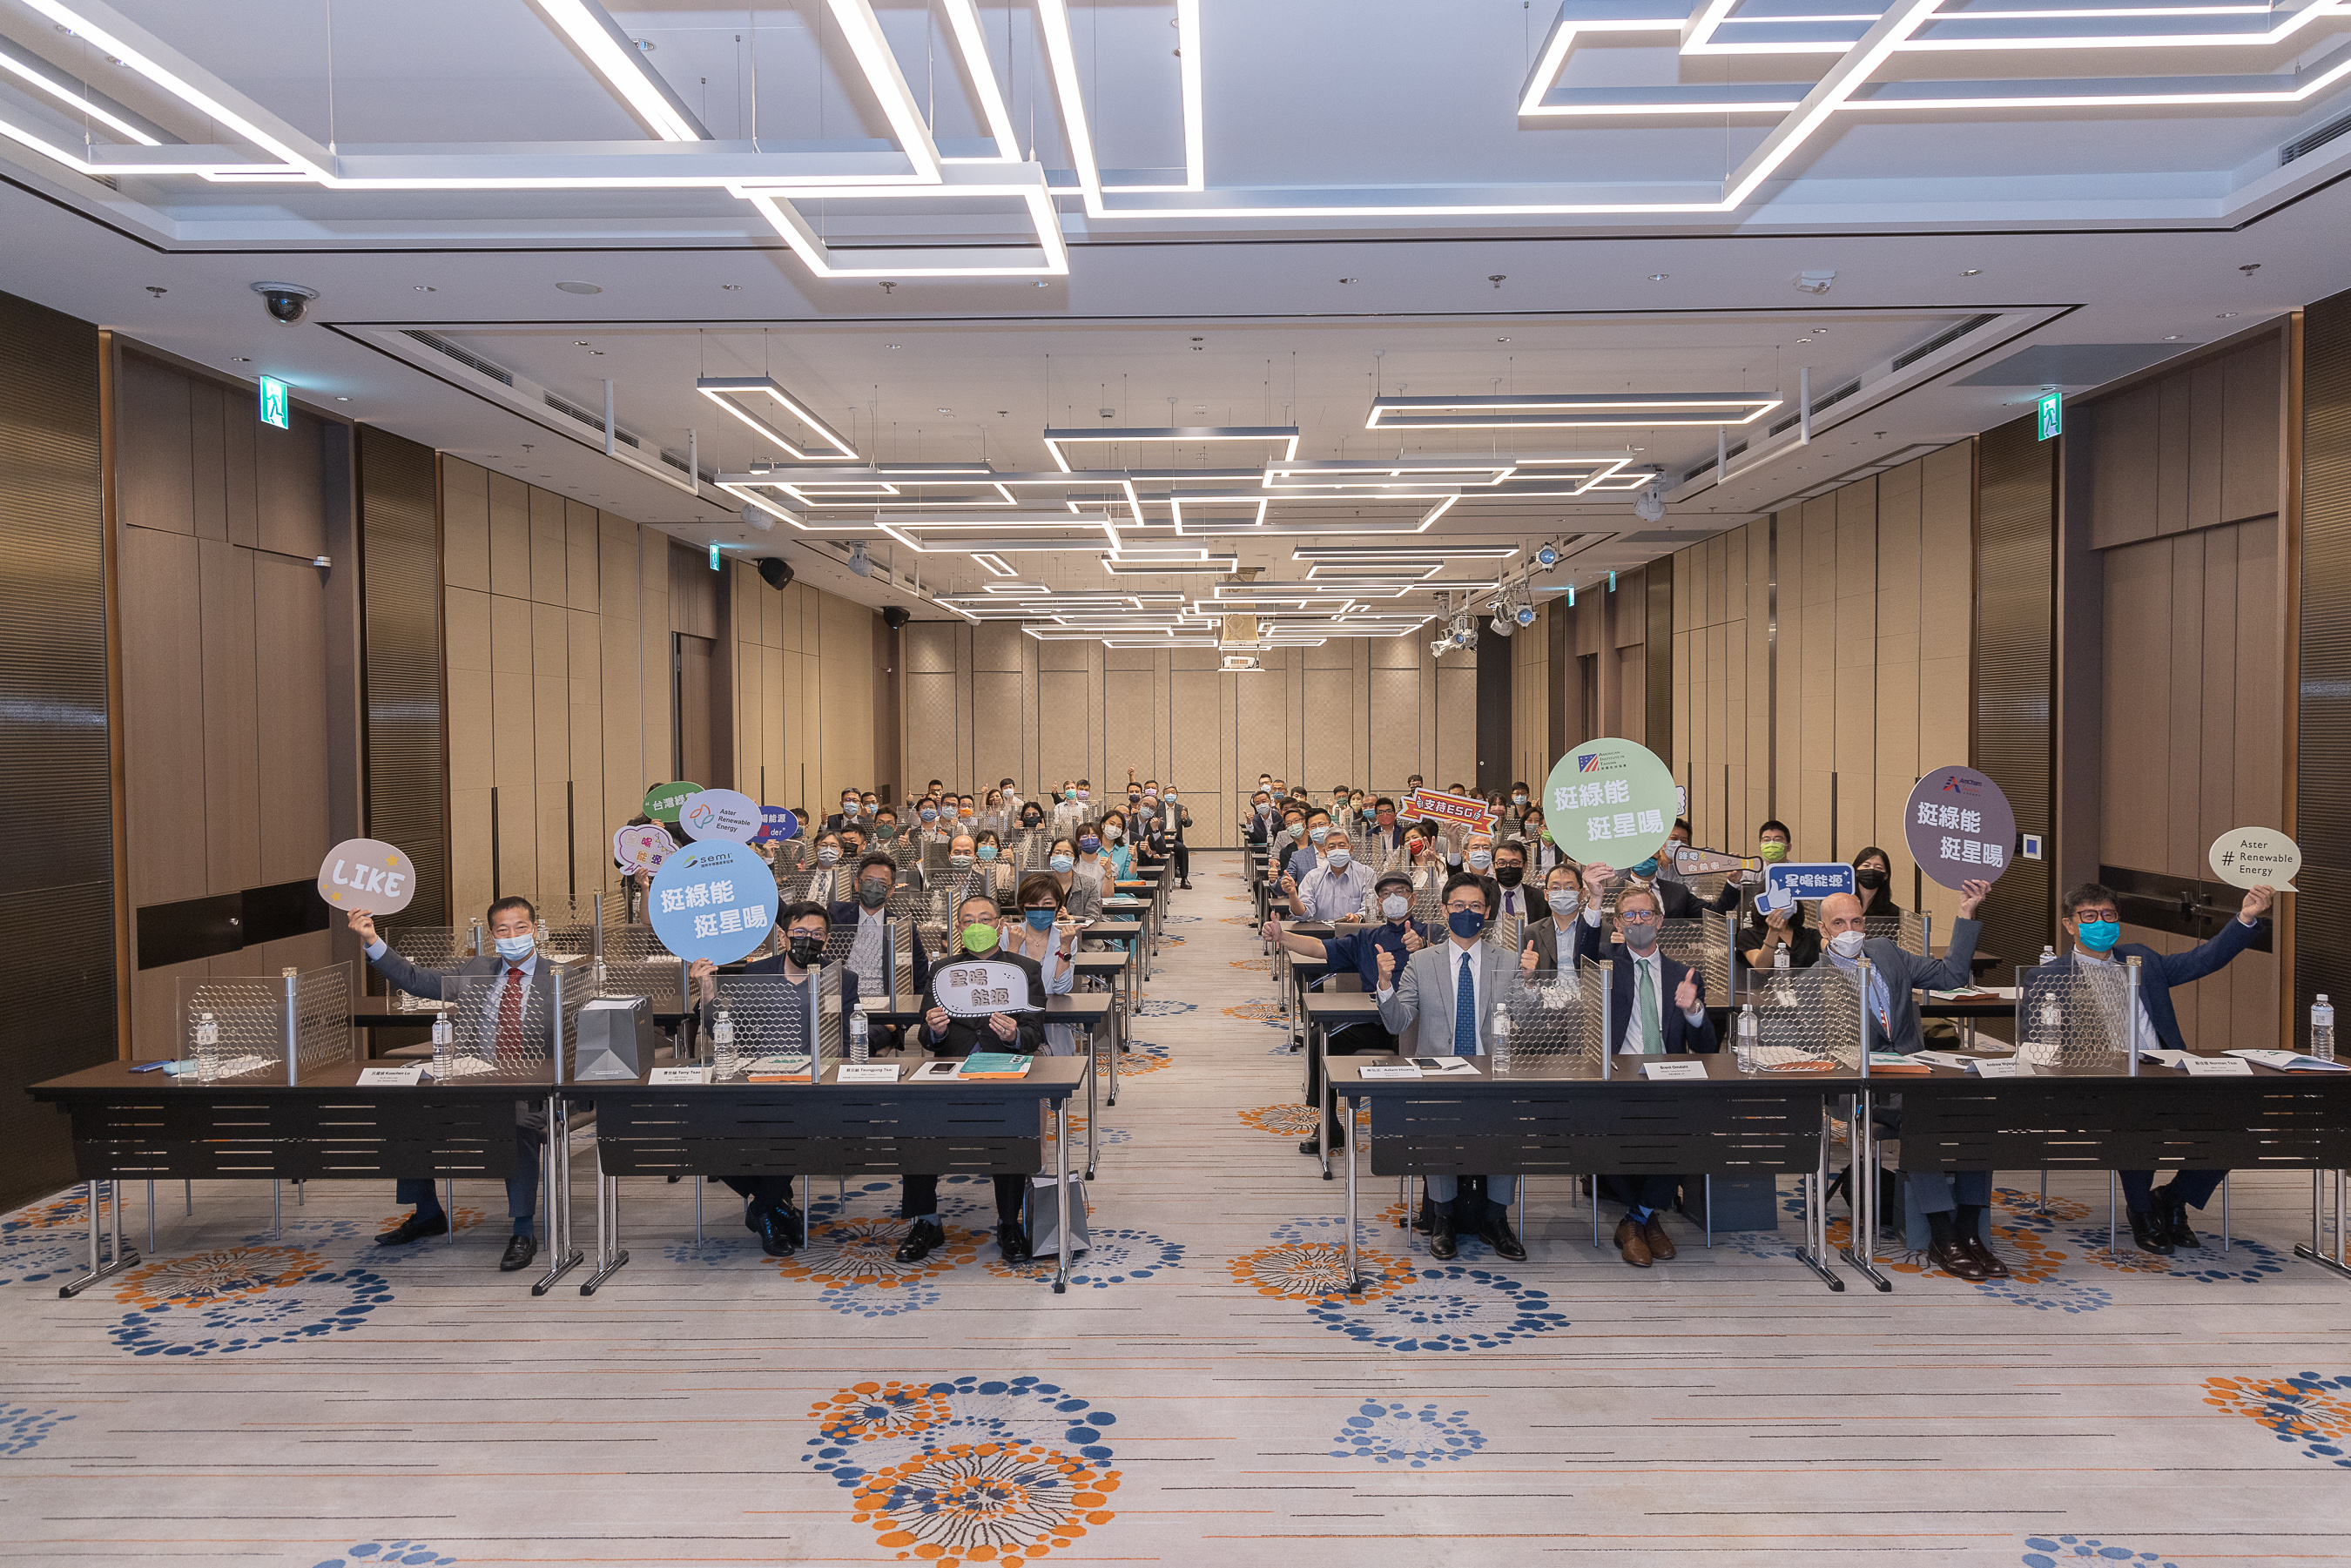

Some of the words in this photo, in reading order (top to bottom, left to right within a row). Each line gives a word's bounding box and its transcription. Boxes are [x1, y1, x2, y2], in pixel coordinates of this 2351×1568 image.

[1554, 779, 1630, 811] 挺綠能
[1424, 799, 1473, 818] 支持ESG
[717, 816, 751, 826] Renewable
[1917, 801, 1981, 833] 挺綠能
[716, 824, 738, 832] Energy
[2240, 839, 2268, 849] Aster
[2240, 851, 2294, 863] Renewable
[332, 858, 406, 898] LIKE
[2240, 865, 2274, 877] Energy
[660, 879, 735, 913] 挺綠能
